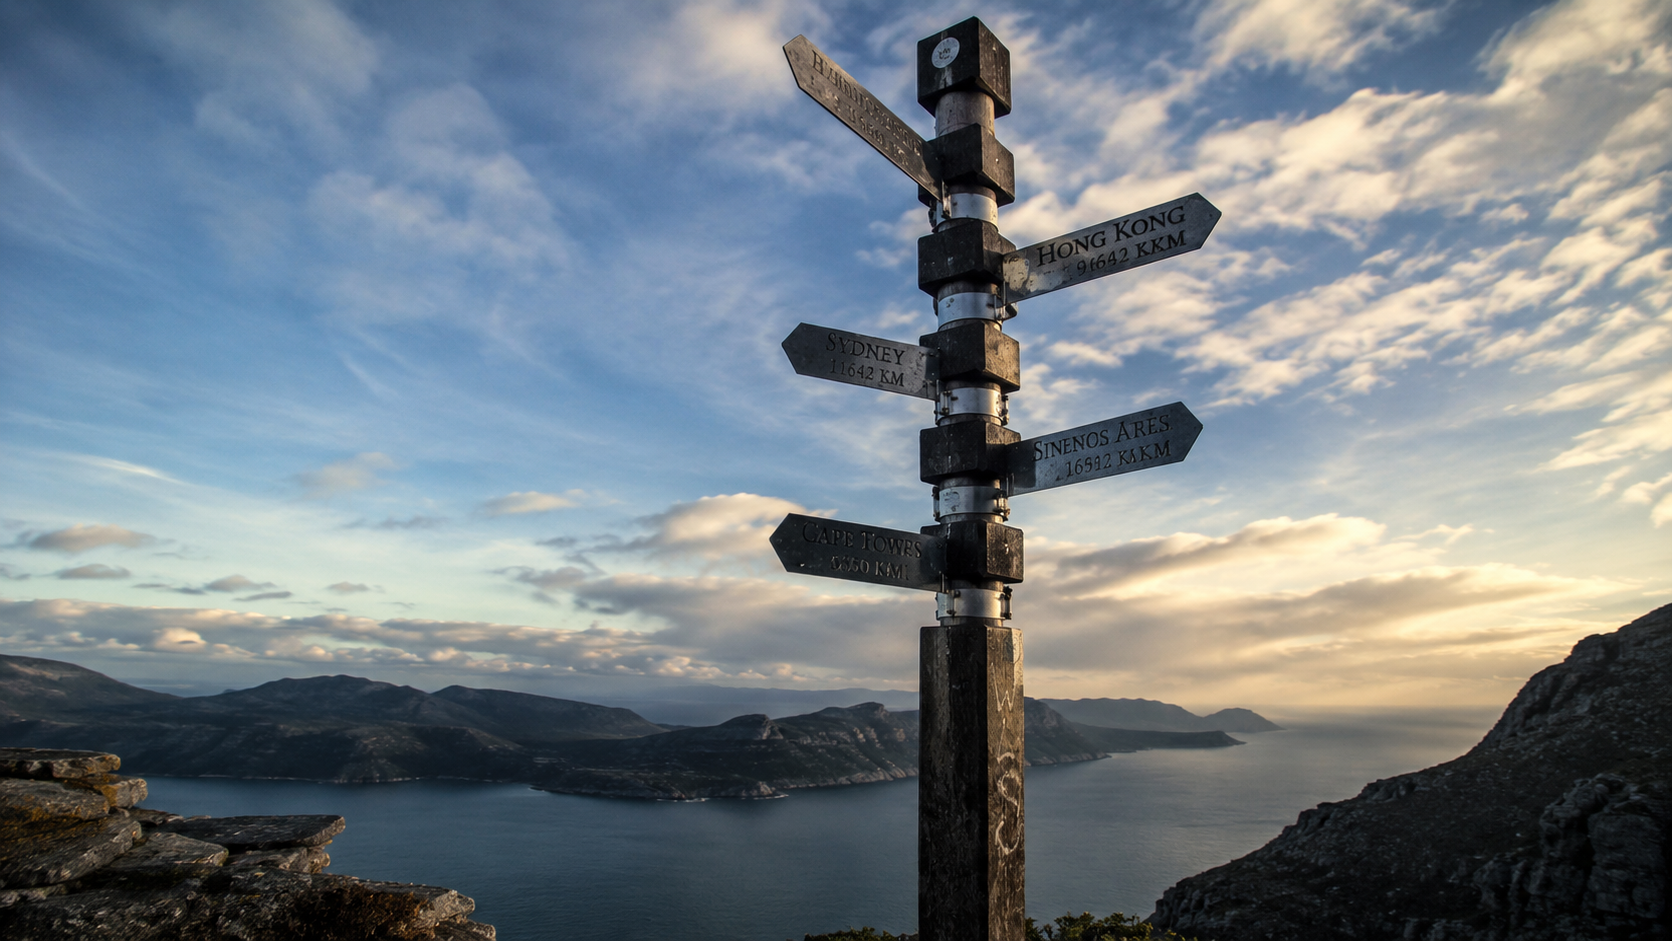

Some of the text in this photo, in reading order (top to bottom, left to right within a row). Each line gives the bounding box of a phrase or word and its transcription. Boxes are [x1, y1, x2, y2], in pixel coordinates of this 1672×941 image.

[1036, 205, 1187, 268] HONG KONG
[1135, 230, 1187, 259] KKM
[826, 332, 906, 366] SYDNEY
[830, 359, 905, 387] 11642 KM
[802, 521, 855, 548] CAPE
